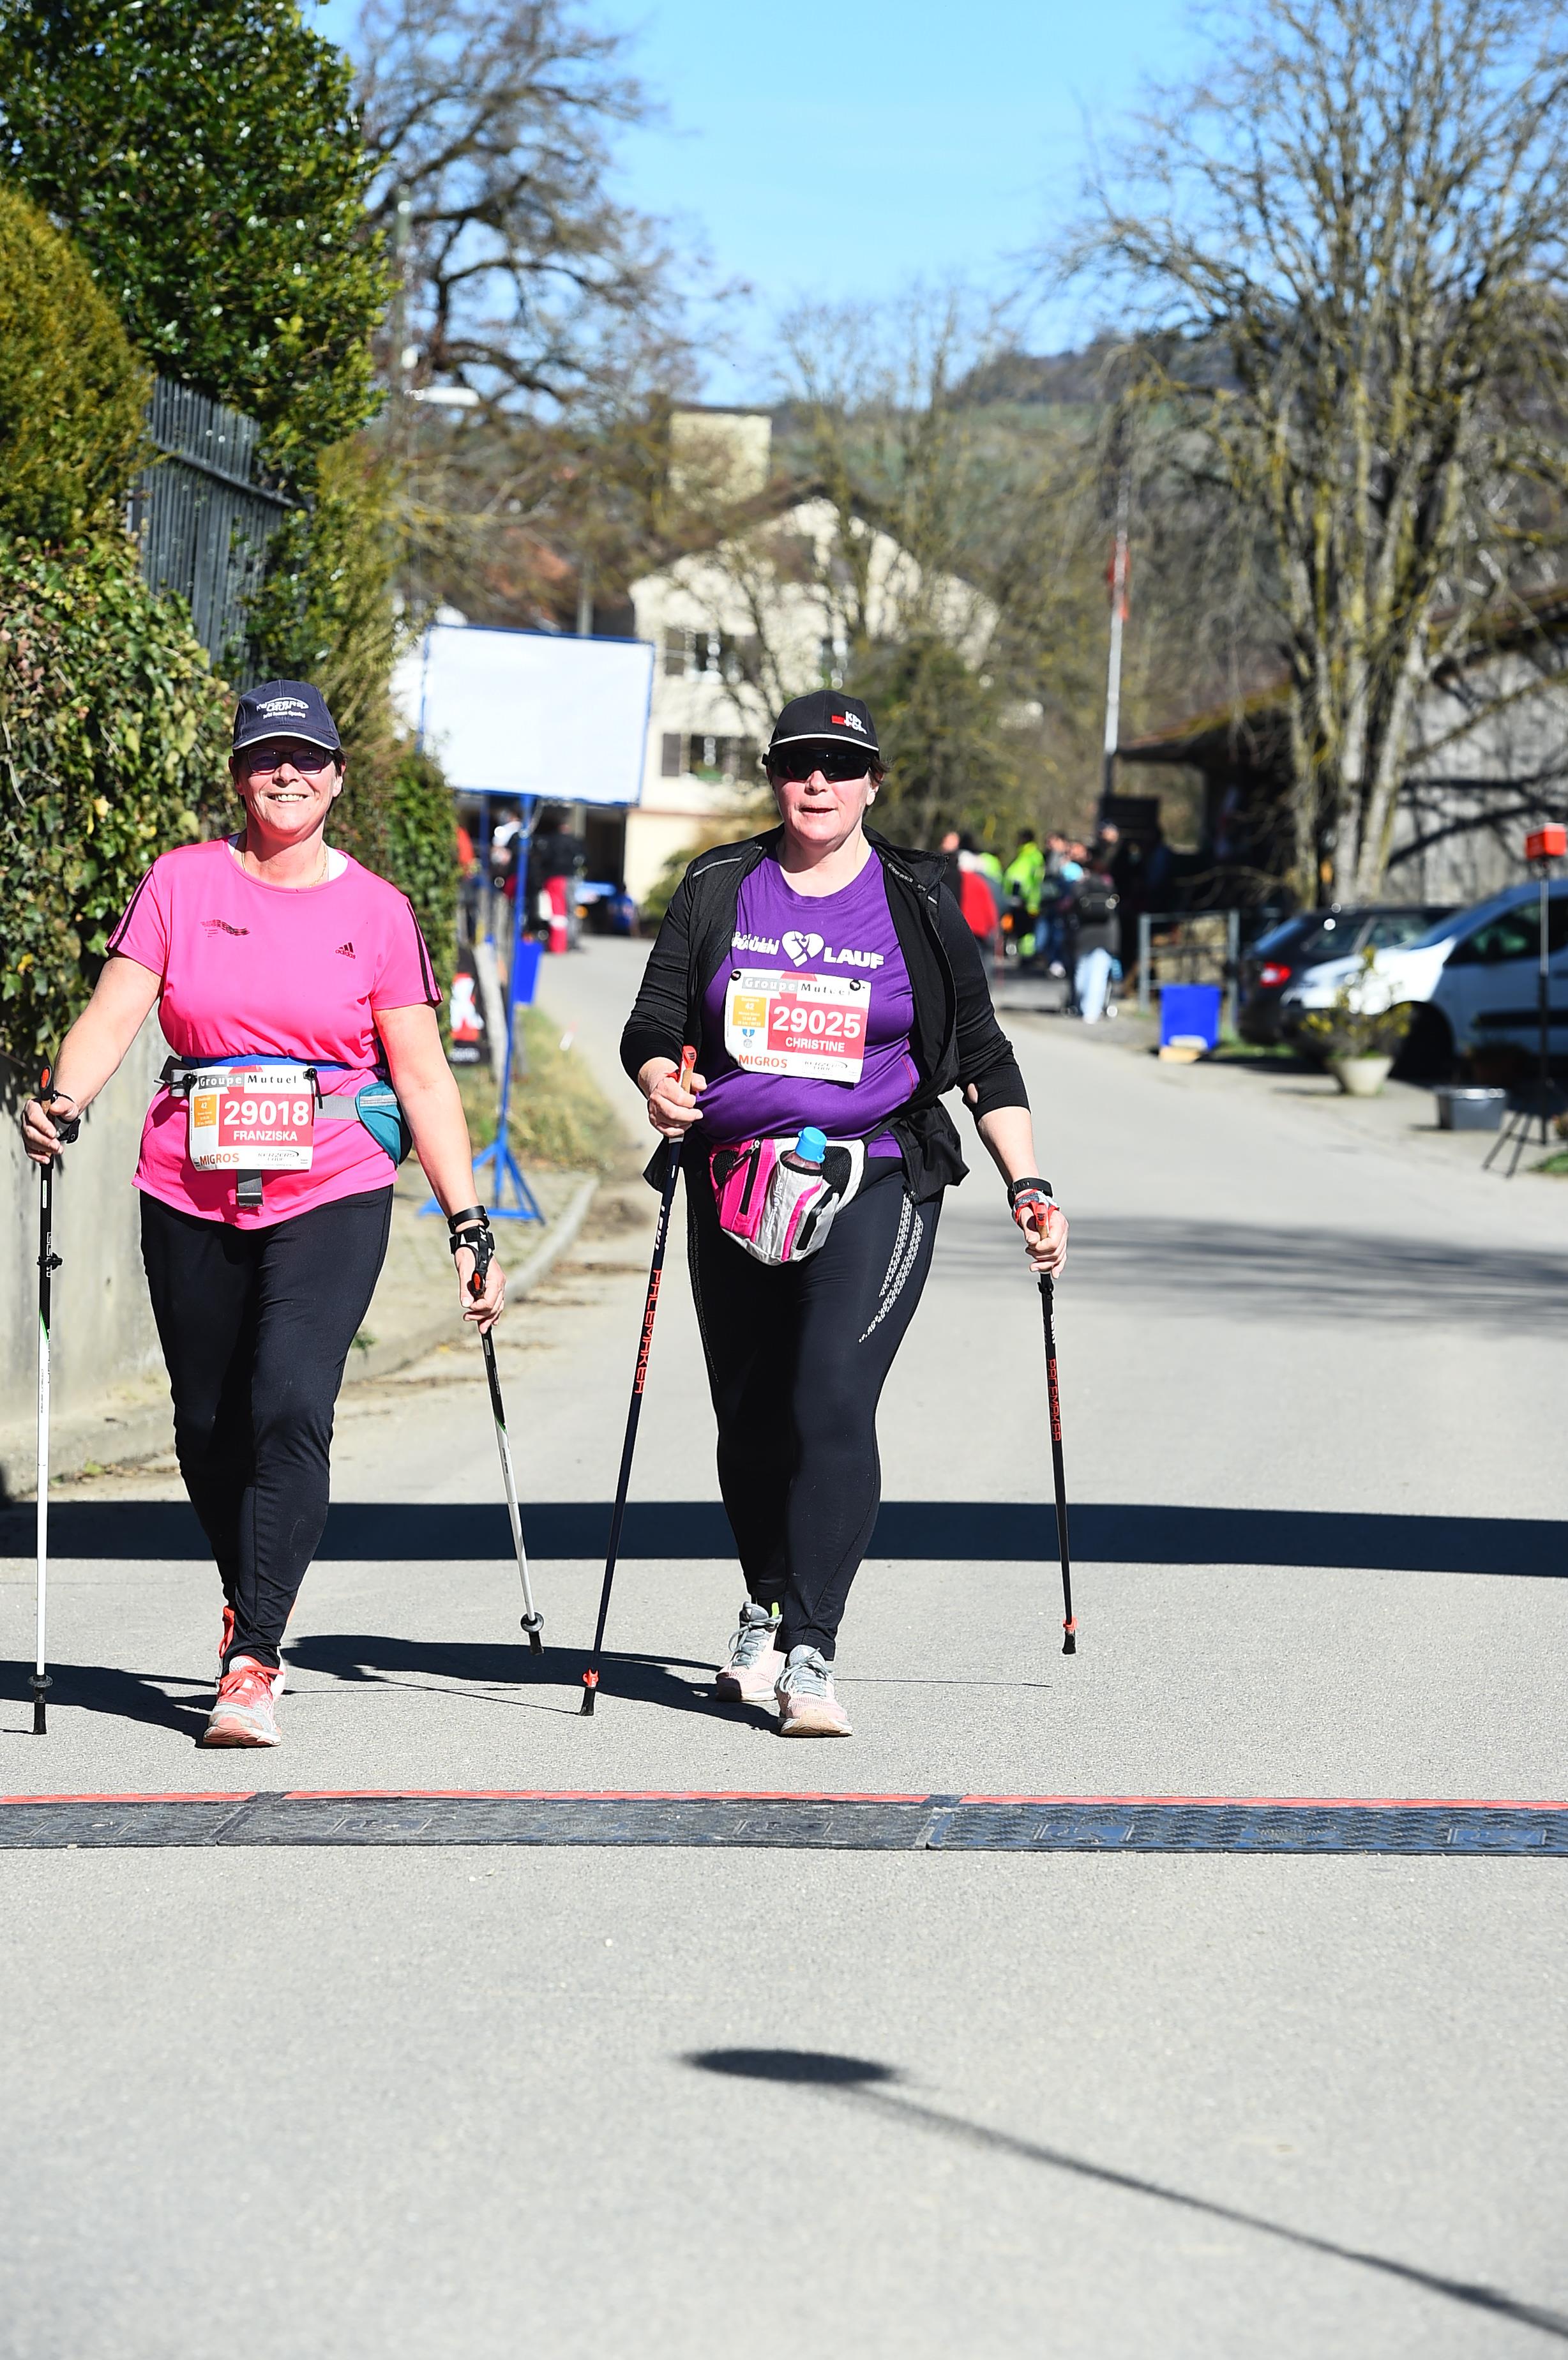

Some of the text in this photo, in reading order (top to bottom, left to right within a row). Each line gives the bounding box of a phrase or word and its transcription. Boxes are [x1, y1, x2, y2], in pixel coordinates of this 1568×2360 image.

[335, 949, 356, 959] adidas
[824, 947, 884, 969] LAUF
[744, 978, 796, 992] Groupe
[773, 1006, 861, 1039] 29025
[785, 1037, 845, 1053] CHRISTINE
[739, 1054, 787, 1068] MIGROS
[200, 1075, 296, 1087] Groupe Mutuel
[223, 1100, 309, 1126] 29018
[233, 1130, 298, 1141] FRANZISKA
[199, 1153, 240, 1166] MIGROS
[1048, 1358, 1062, 1441] PACEMAKER
